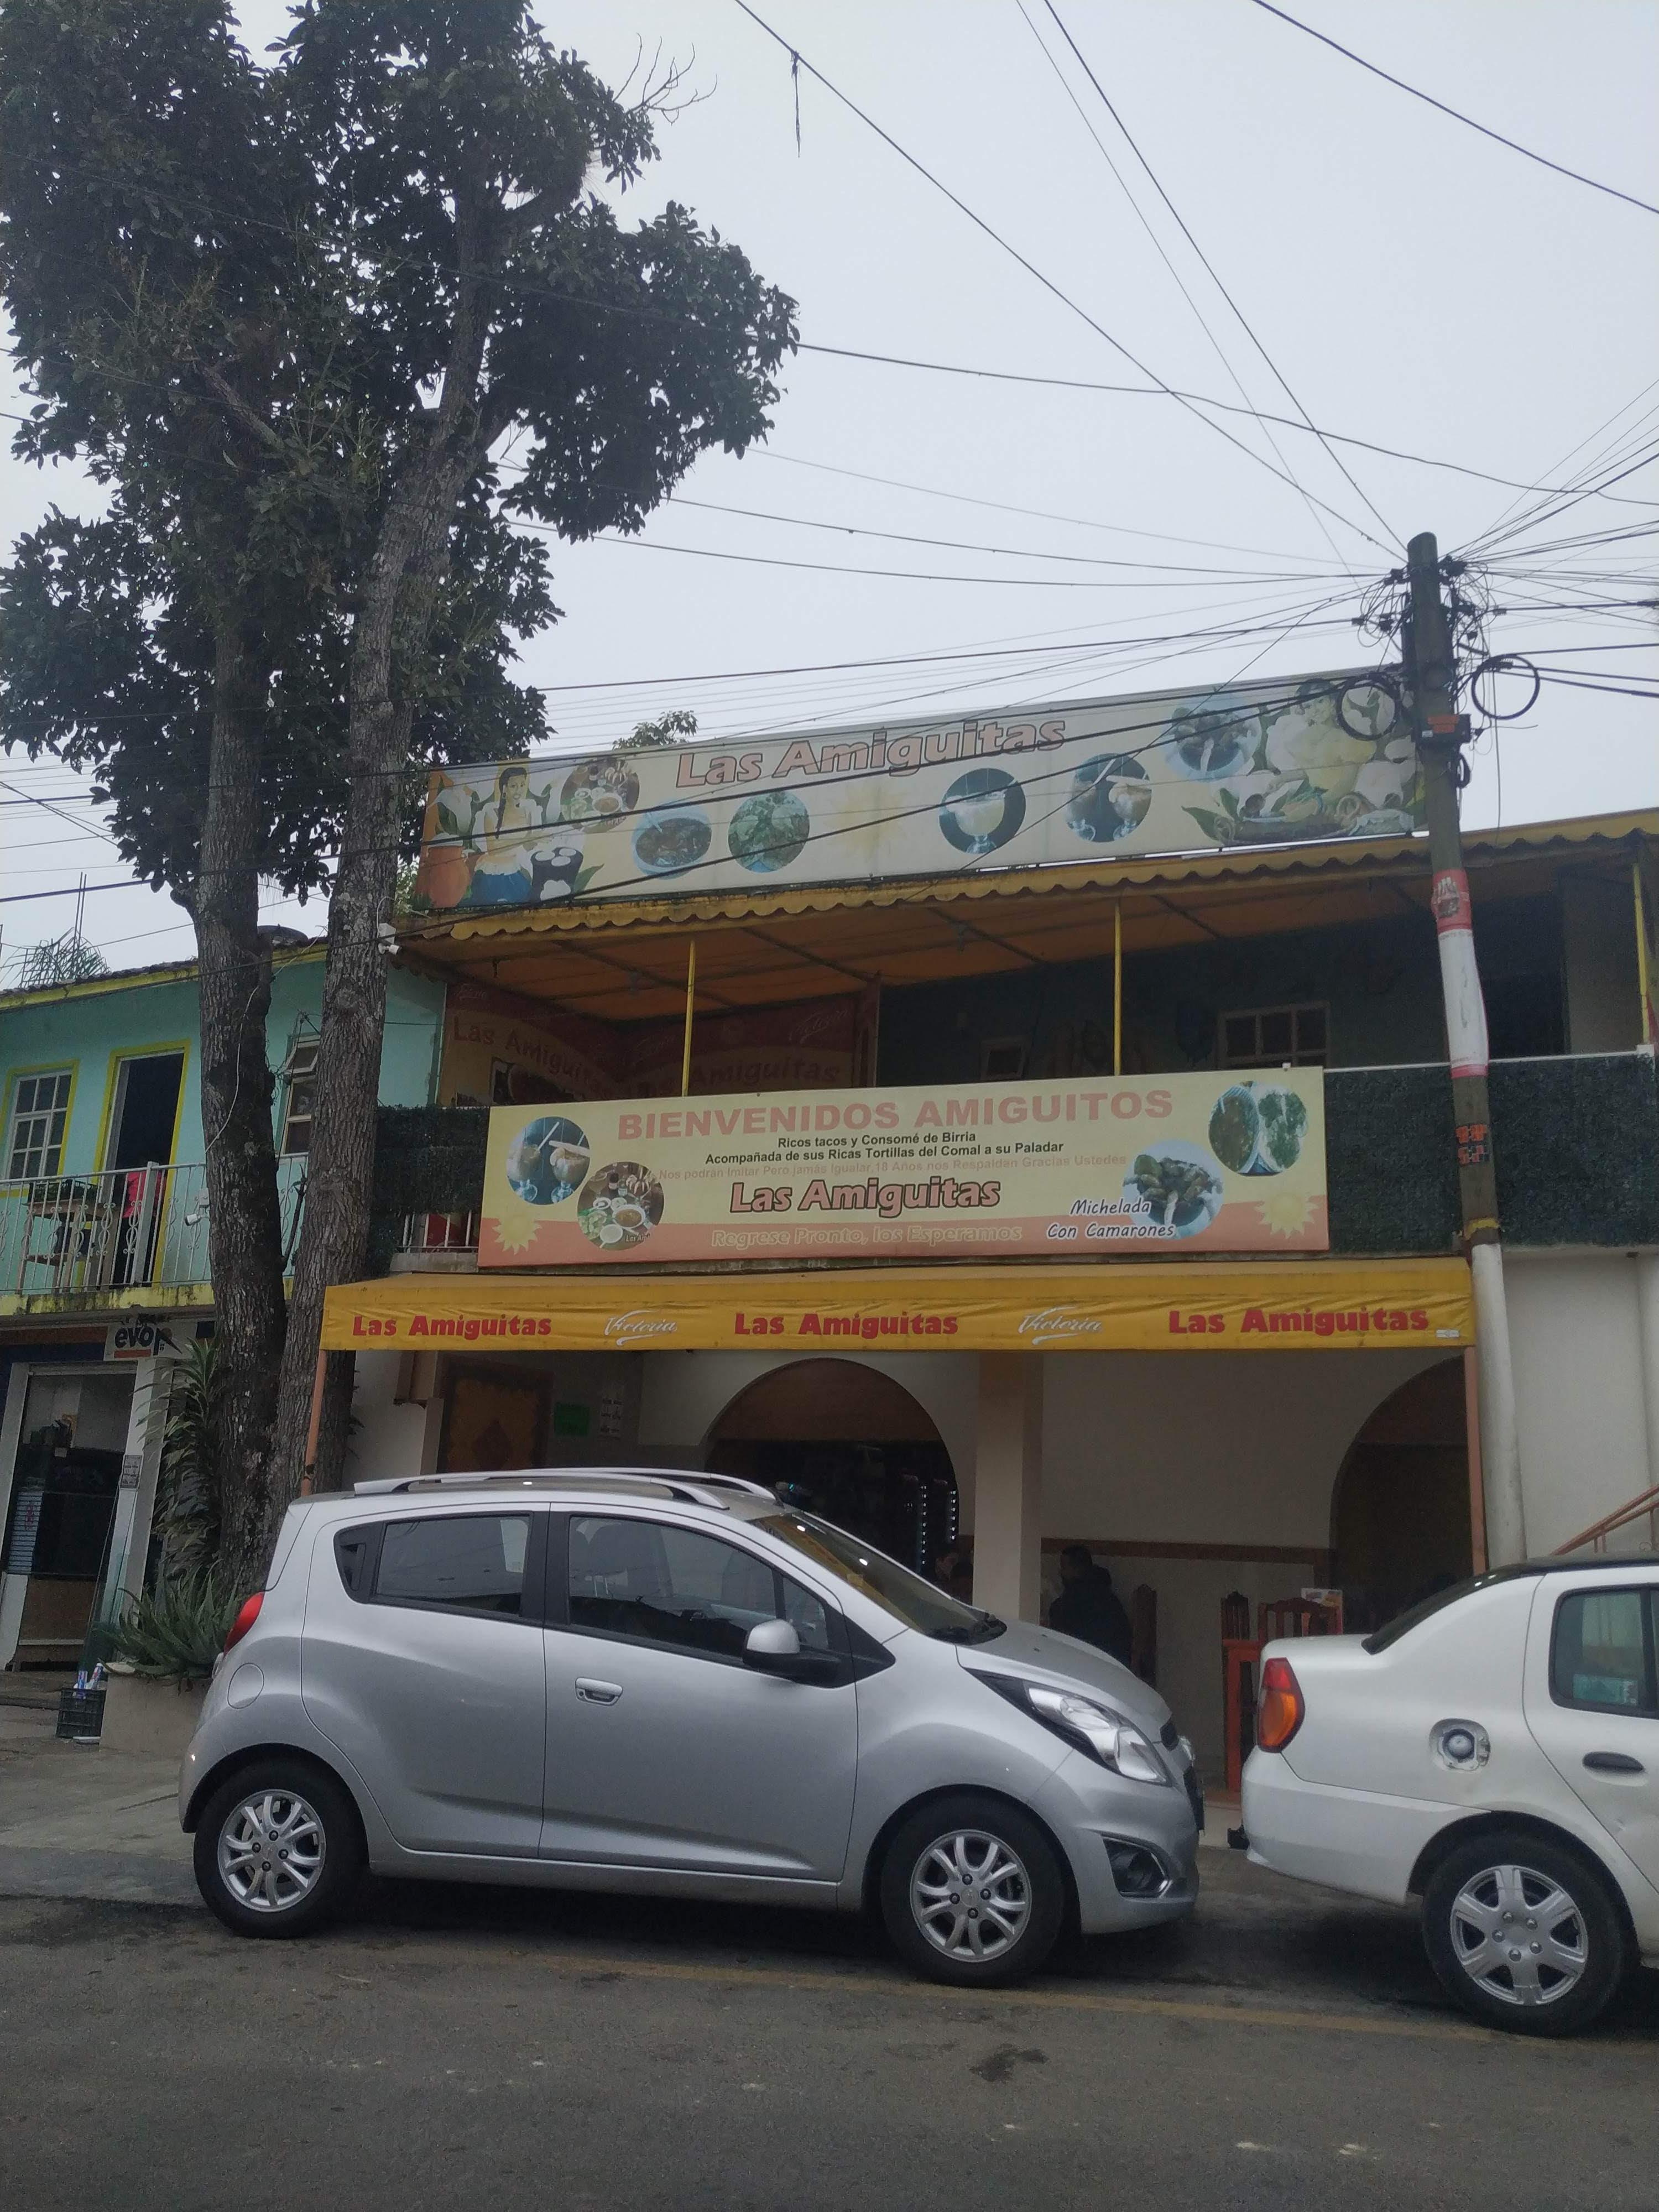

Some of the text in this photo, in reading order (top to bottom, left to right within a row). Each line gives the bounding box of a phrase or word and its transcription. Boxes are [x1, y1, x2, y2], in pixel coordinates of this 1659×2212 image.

[676, 720, 1066, 788] Las Amiguitas
[451, 1016, 494, 1045] Las
[691, 1055, 841, 1087] Amiguitas
[618, 1089, 1173, 1140] BIENVENIDOS AMIGUITOS
[705, 1141, 1064, 1165] Acompañada de sus Ricas Tortillas del Comal a su Paladar
[778, 1131, 976, 1149] Ricos tacos y Consomé de Birria
[660, 1169, 680, 1180] Nos
[684, 1166, 723, 1180] podrán
[764, 1164, 789, 1176] Pero
[1022, 1156, 1070, 1168] Gracias
[1074, 1154, 1126, 1166] Ustedes
[729, 1176, 1001, 1219] Las Amiguitas
[1070, 1197, 1151, 1215] Michelada
[711, 1225, 1022, 1250] Regrese Pronto, los Esperamos
[1047, 1222, 1176, 1239] Con Camarones
[352, 1313, 552, 1340] Las Amiguitas
[604, 1310, 678, 1346] Victoria
[734, 1311, 958, 1342] Las Amiguitas
[1018, 1304, 1103, 1345] Victoria
[1168, 1307, 1430, 1338] Las Amiguitas
